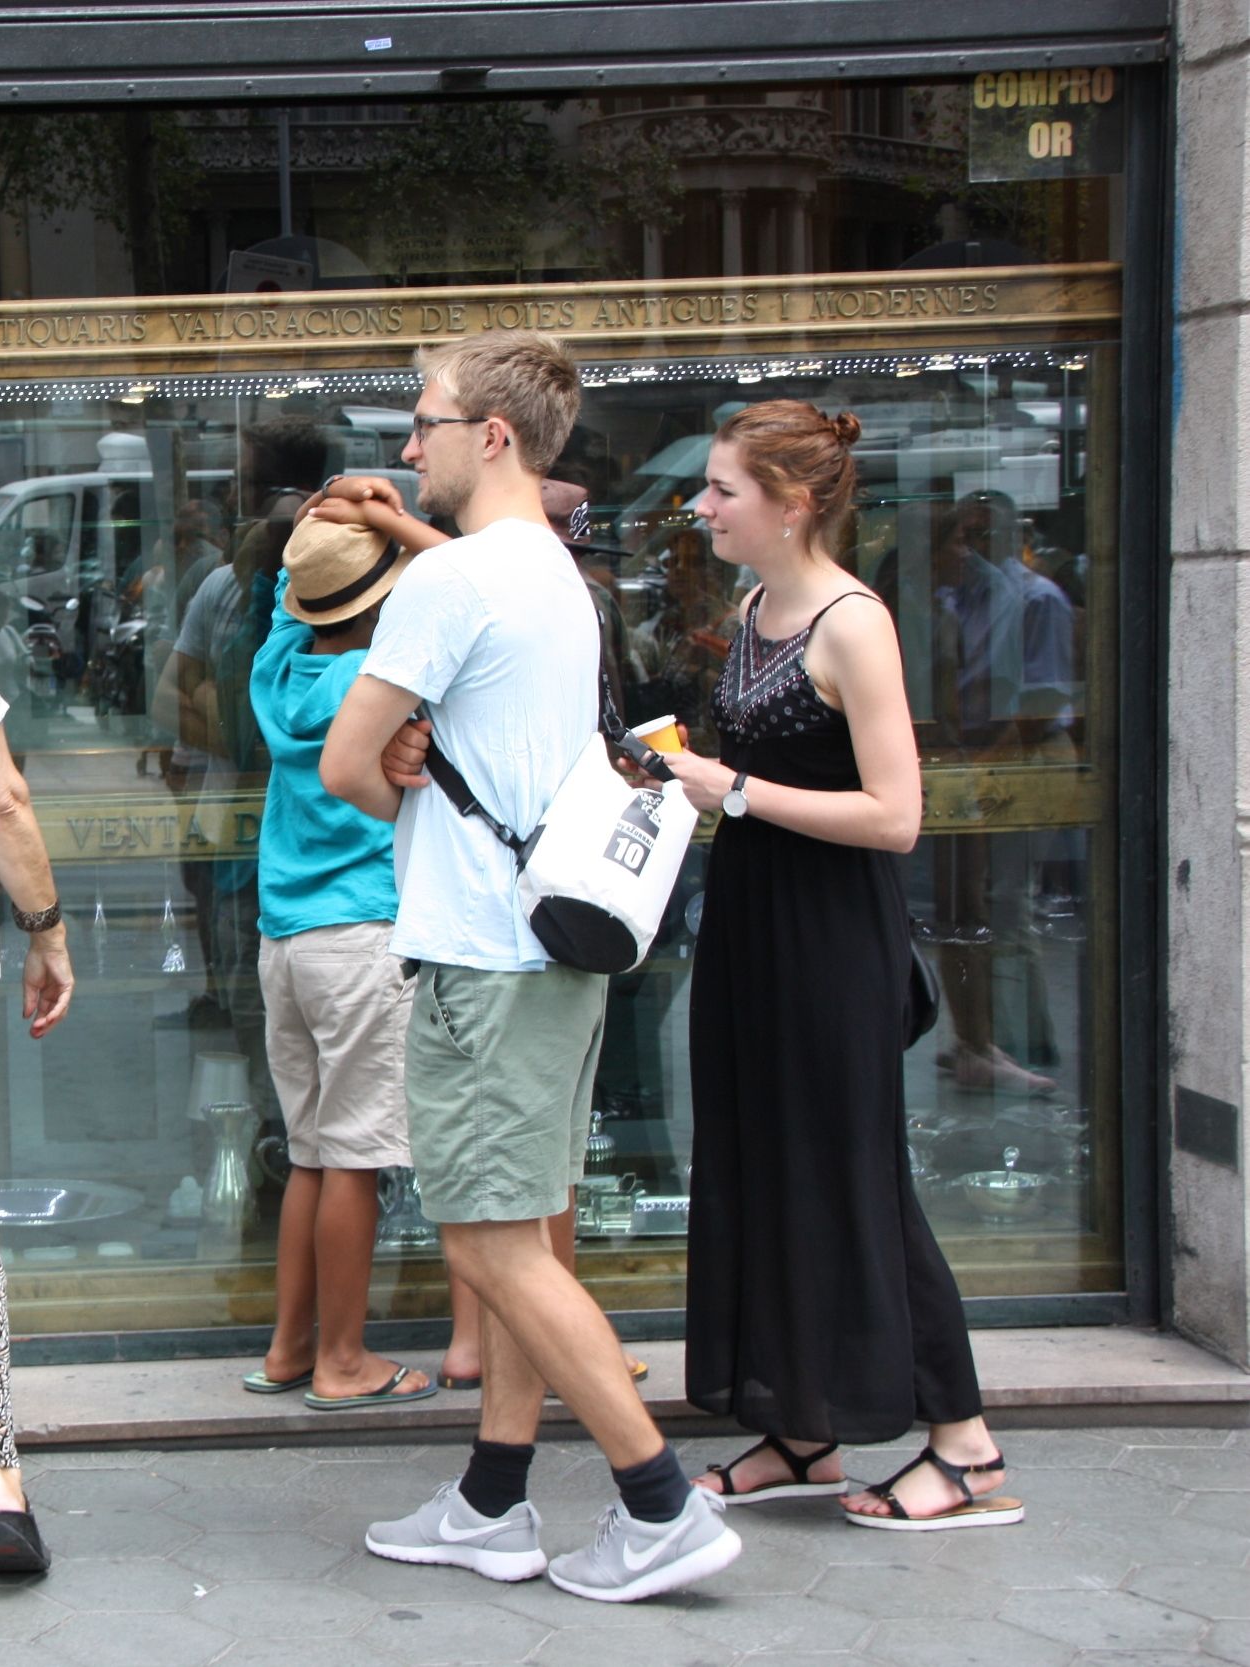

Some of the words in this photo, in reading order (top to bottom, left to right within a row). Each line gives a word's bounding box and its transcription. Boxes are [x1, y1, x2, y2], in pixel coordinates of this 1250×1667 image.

[973, 65, 1114, 109] COMPRO
[1028, 121, 1073, 159] OR
[169, 305, 403, 342] VALORACIONS
[420, 303, 468, 332] DE
[483, 301, 575, 330] JOIES
[592, 294, 759, 327] ANTIGUES
[779, 291, 791, 321] I
[808, 284, 998, 320] MODERNES
[67, 814, 208, 850] VENTA
[613, 837, 644, 869] 10
